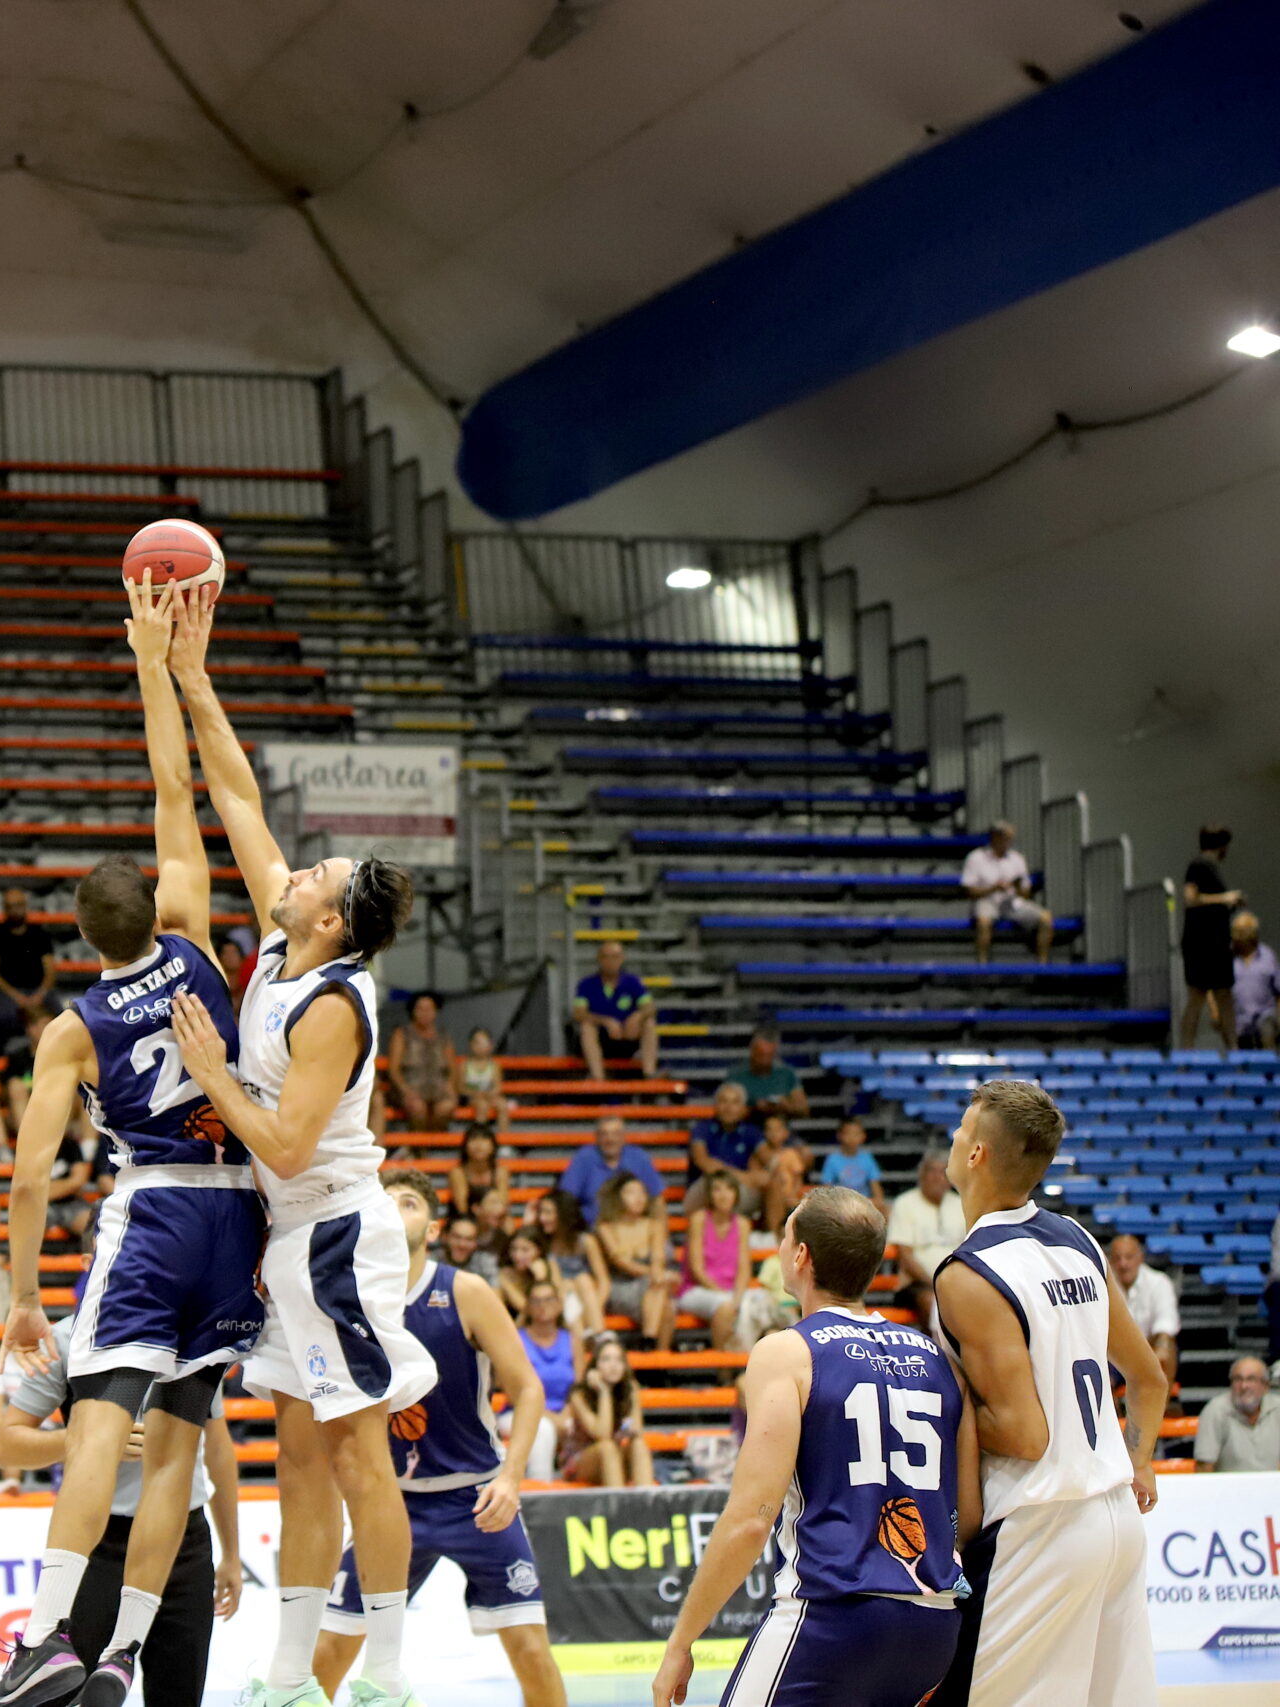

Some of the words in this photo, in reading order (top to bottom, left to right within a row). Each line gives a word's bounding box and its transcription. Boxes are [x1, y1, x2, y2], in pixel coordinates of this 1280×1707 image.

[289, 754, 427, 791] Gastarea
[107, 956, 186, 1010] GAETANO
[844, 1382, 942, 1491] 15
[1147, 1586, 1193, 1604] FOOD
[1198, 1586, 1210, 1601] &
[1215, 1584, 1280, 1601] BEVERA
